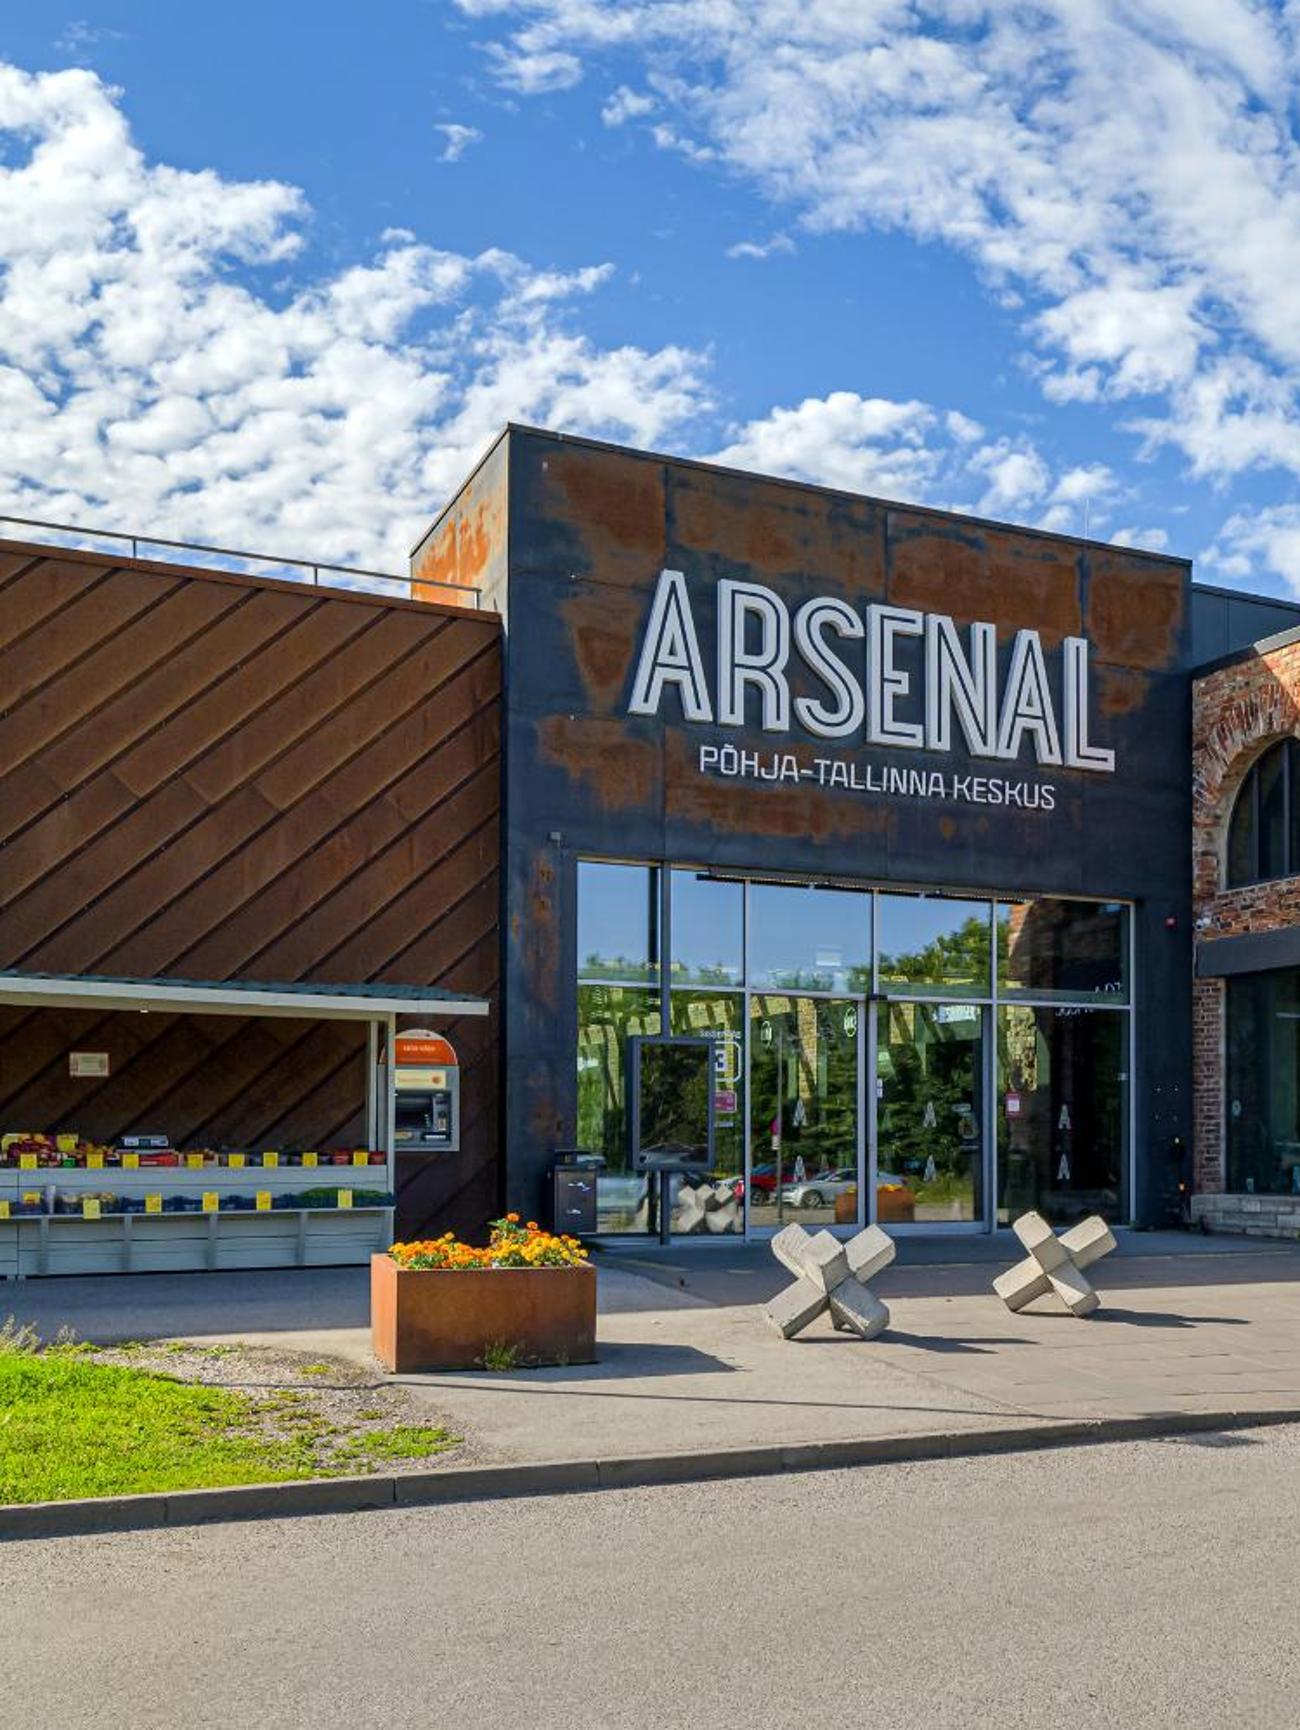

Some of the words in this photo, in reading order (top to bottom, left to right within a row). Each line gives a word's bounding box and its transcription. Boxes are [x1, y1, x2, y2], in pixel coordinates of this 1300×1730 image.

[627, 569, 1116, 773] ARSENAL
[699, 743, 946, 799] PÕHJA-TALLINNA
[953, 774, 1056, 810] KESKUS
